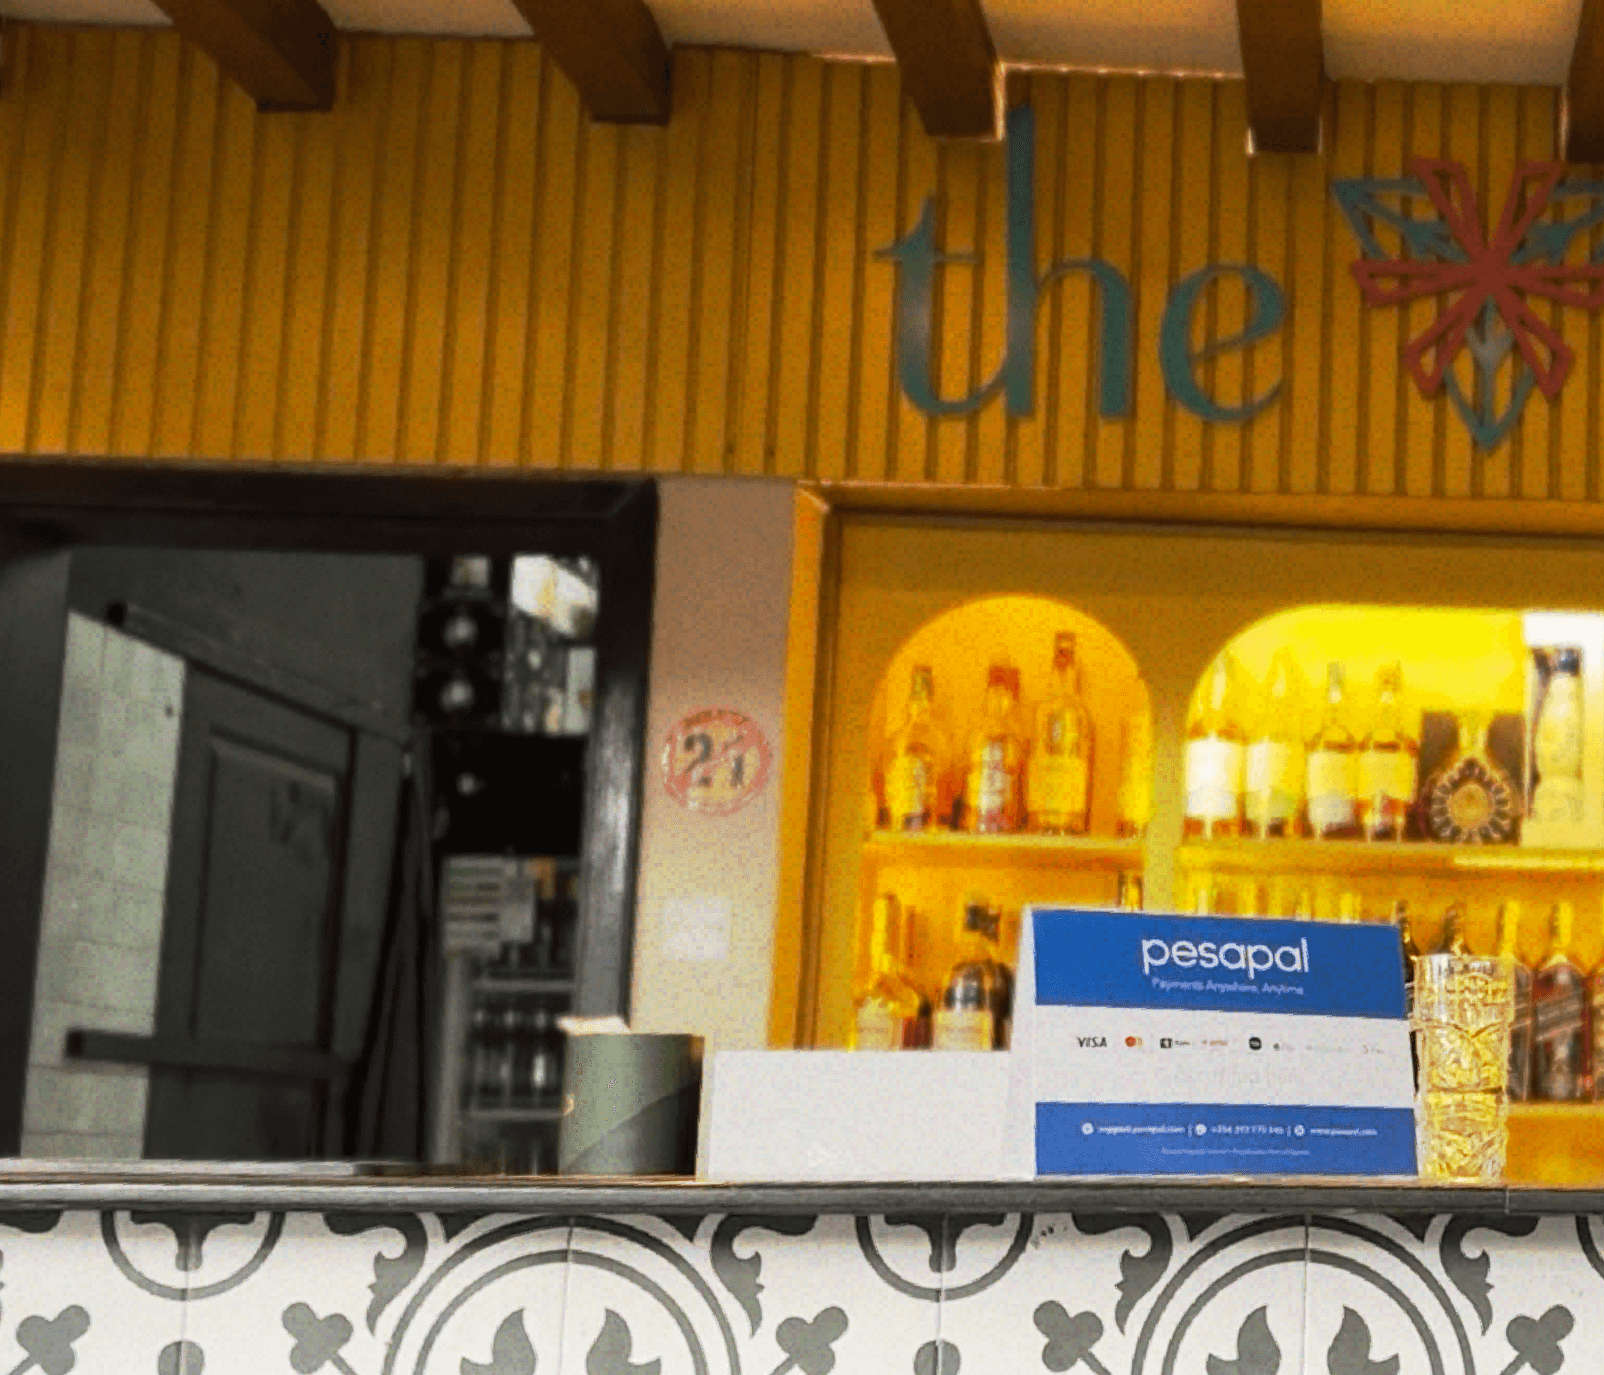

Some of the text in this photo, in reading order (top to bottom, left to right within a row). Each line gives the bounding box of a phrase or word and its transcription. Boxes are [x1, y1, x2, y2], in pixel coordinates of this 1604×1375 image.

[872, 104, 1292, 423] the
[1142, 937, 1309, 980] pesapal
[1077, 1036, 1108, 1048] VISA
